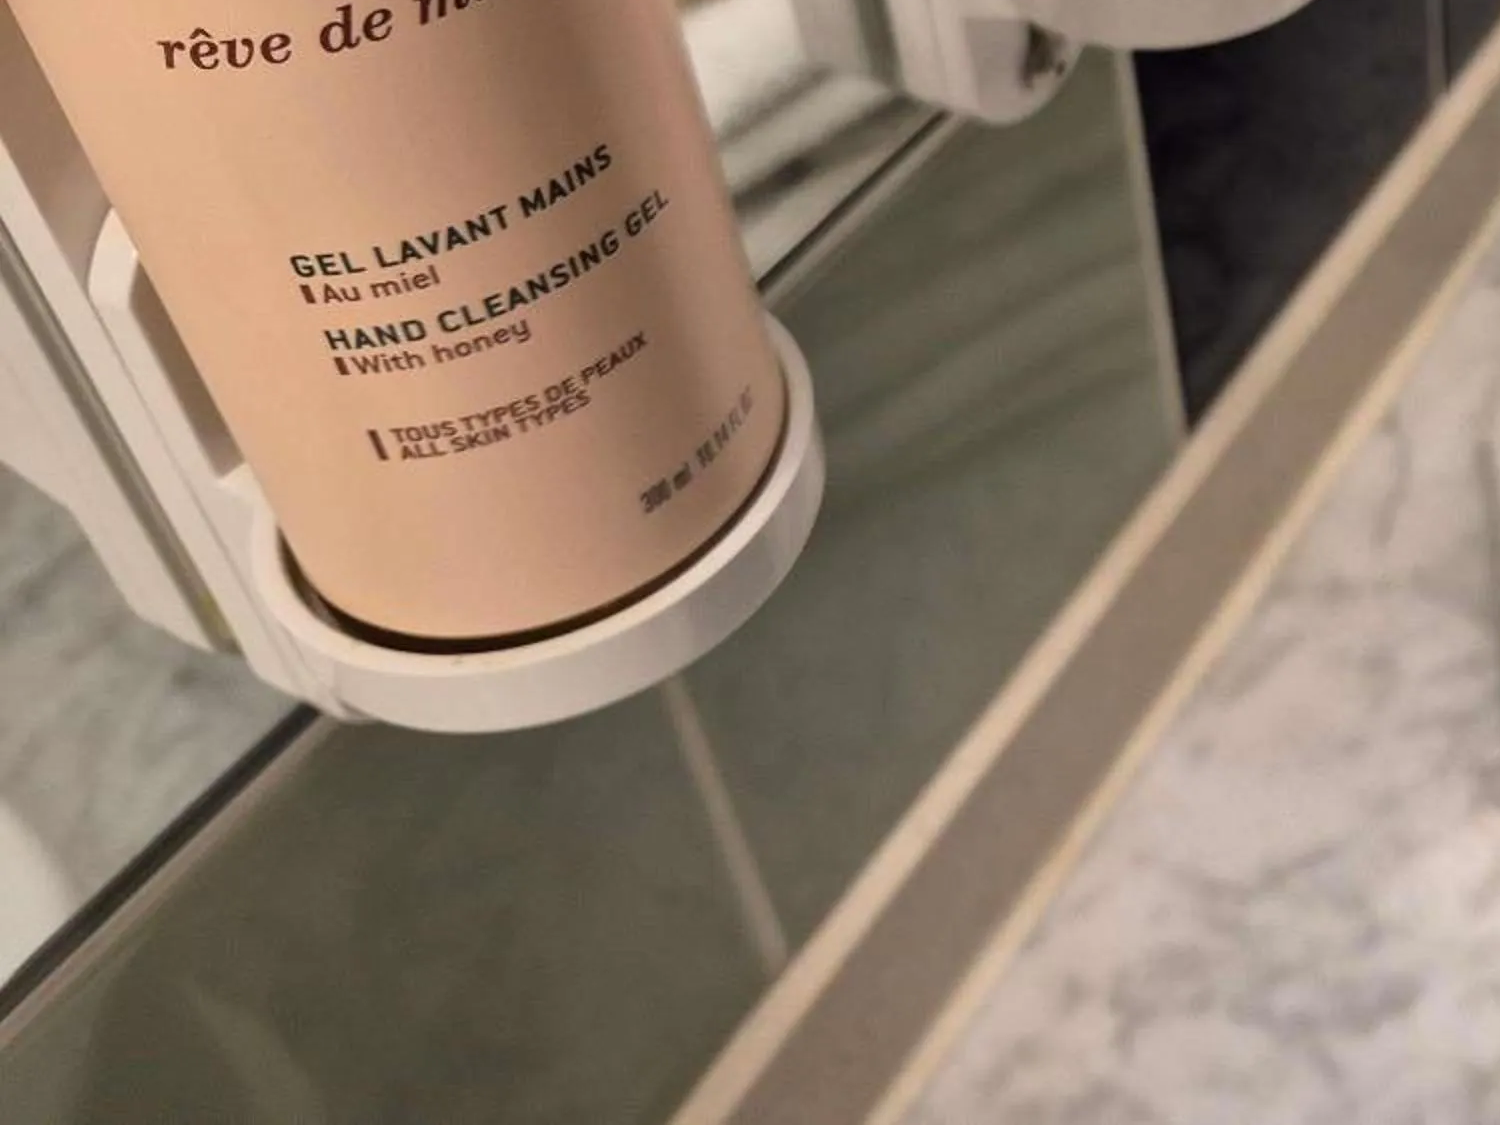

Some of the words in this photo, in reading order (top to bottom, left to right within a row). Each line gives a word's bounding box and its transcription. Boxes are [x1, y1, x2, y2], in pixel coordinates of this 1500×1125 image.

[156, 27, 293, 70] rêve
[318, 5, 394, 54] de
[289, 251, 368, 278] GEL
[371, 204, 509, 269] LAVANT
[517, 143, 613, 219] MAINS
[323, 319, 428, 351] HAND
[436, 228, 620, 334] CLEANSING
[624, 189, 670, 238] GEL
[323, 282, 363, 305] Au
[369, 264, 441, 299] miel
[350, 350, 427, 375] With
[430, 318, 533, 364] honey
[389, 420, 457, 444] TOUS
[459, 393, 542, 431] TYPES
[543, 376, 579, 404] DE
[580, 330, 649, 386] PEAUX
[400, 441, 452, 462] ALL
[450, 423, 512, 454] SKIN
[514, 388, 593, 433] TYPES
